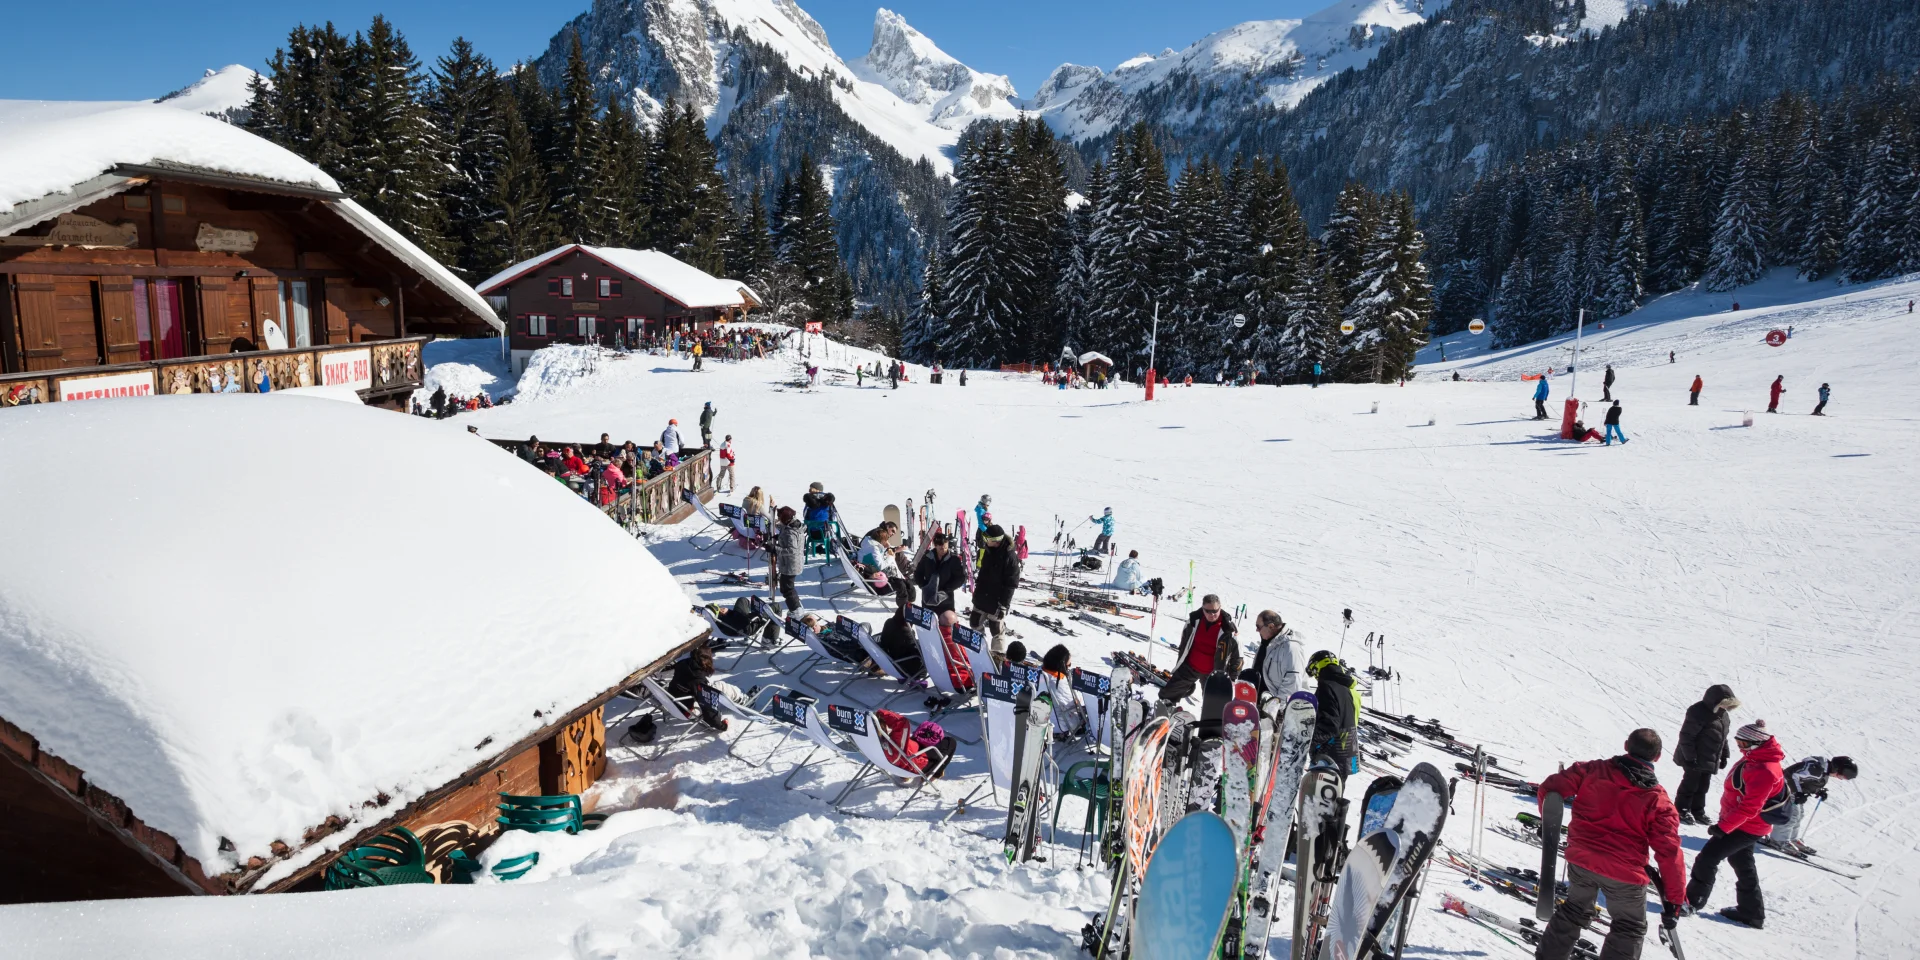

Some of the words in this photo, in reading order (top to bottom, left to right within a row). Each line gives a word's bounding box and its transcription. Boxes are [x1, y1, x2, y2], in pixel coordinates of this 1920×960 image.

[1772, 334, 1780, 342] 3
[325, 362, 349, 386] SNACK
[353, 359, 369, 382] BAR
[1010, 662, 1025, 675] burn
[991, 675, 1008, 689] burn
[1081, 671, 1096, 684] burn
[780, 698, 794, 711] burn
[836, 706, 852, 720] burn
